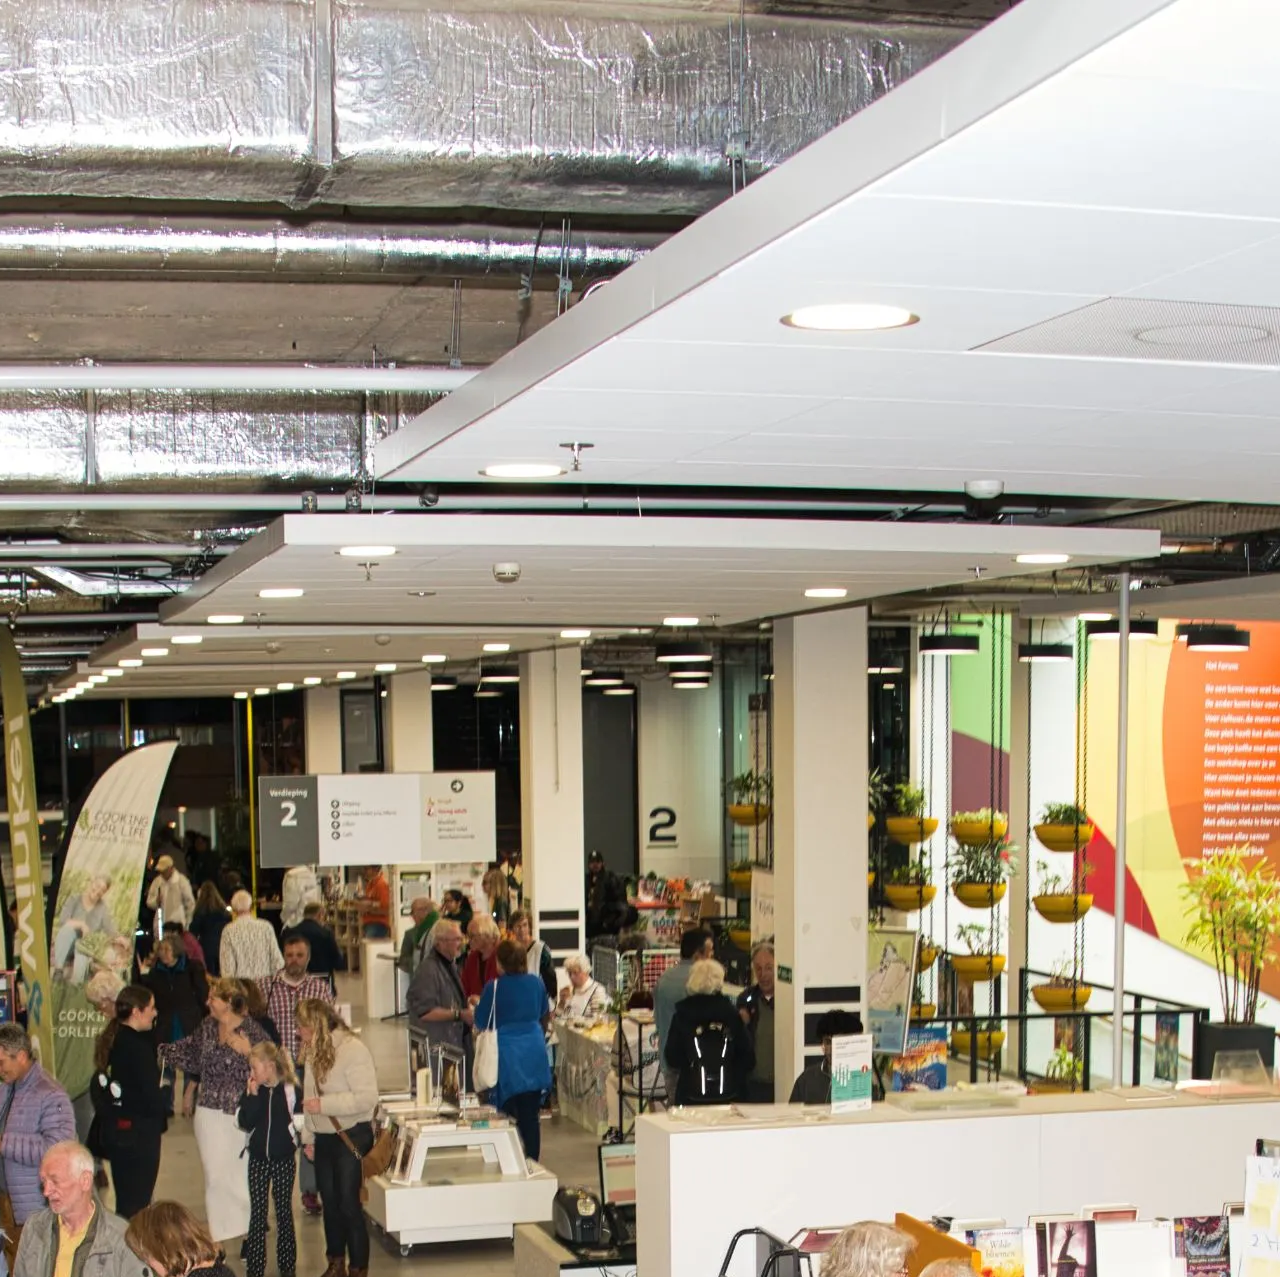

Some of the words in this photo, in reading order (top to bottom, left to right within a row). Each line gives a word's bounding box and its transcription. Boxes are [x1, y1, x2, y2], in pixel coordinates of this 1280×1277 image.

[269, 788, 308, 799] Verdieping
[94, 809, 149, 827] COOKING
[280, 802, 298, 827] 2
[92, 824, 116, 837] FOR
[120, 825, 145, 837] LIFE
[649, 806, 677, 842] 2
[51, 1026, 106, 1039] FORLIF
[990, 1239, 1011, 1249] Wilde
[985, 1249, 1016, 1258] bloemen
